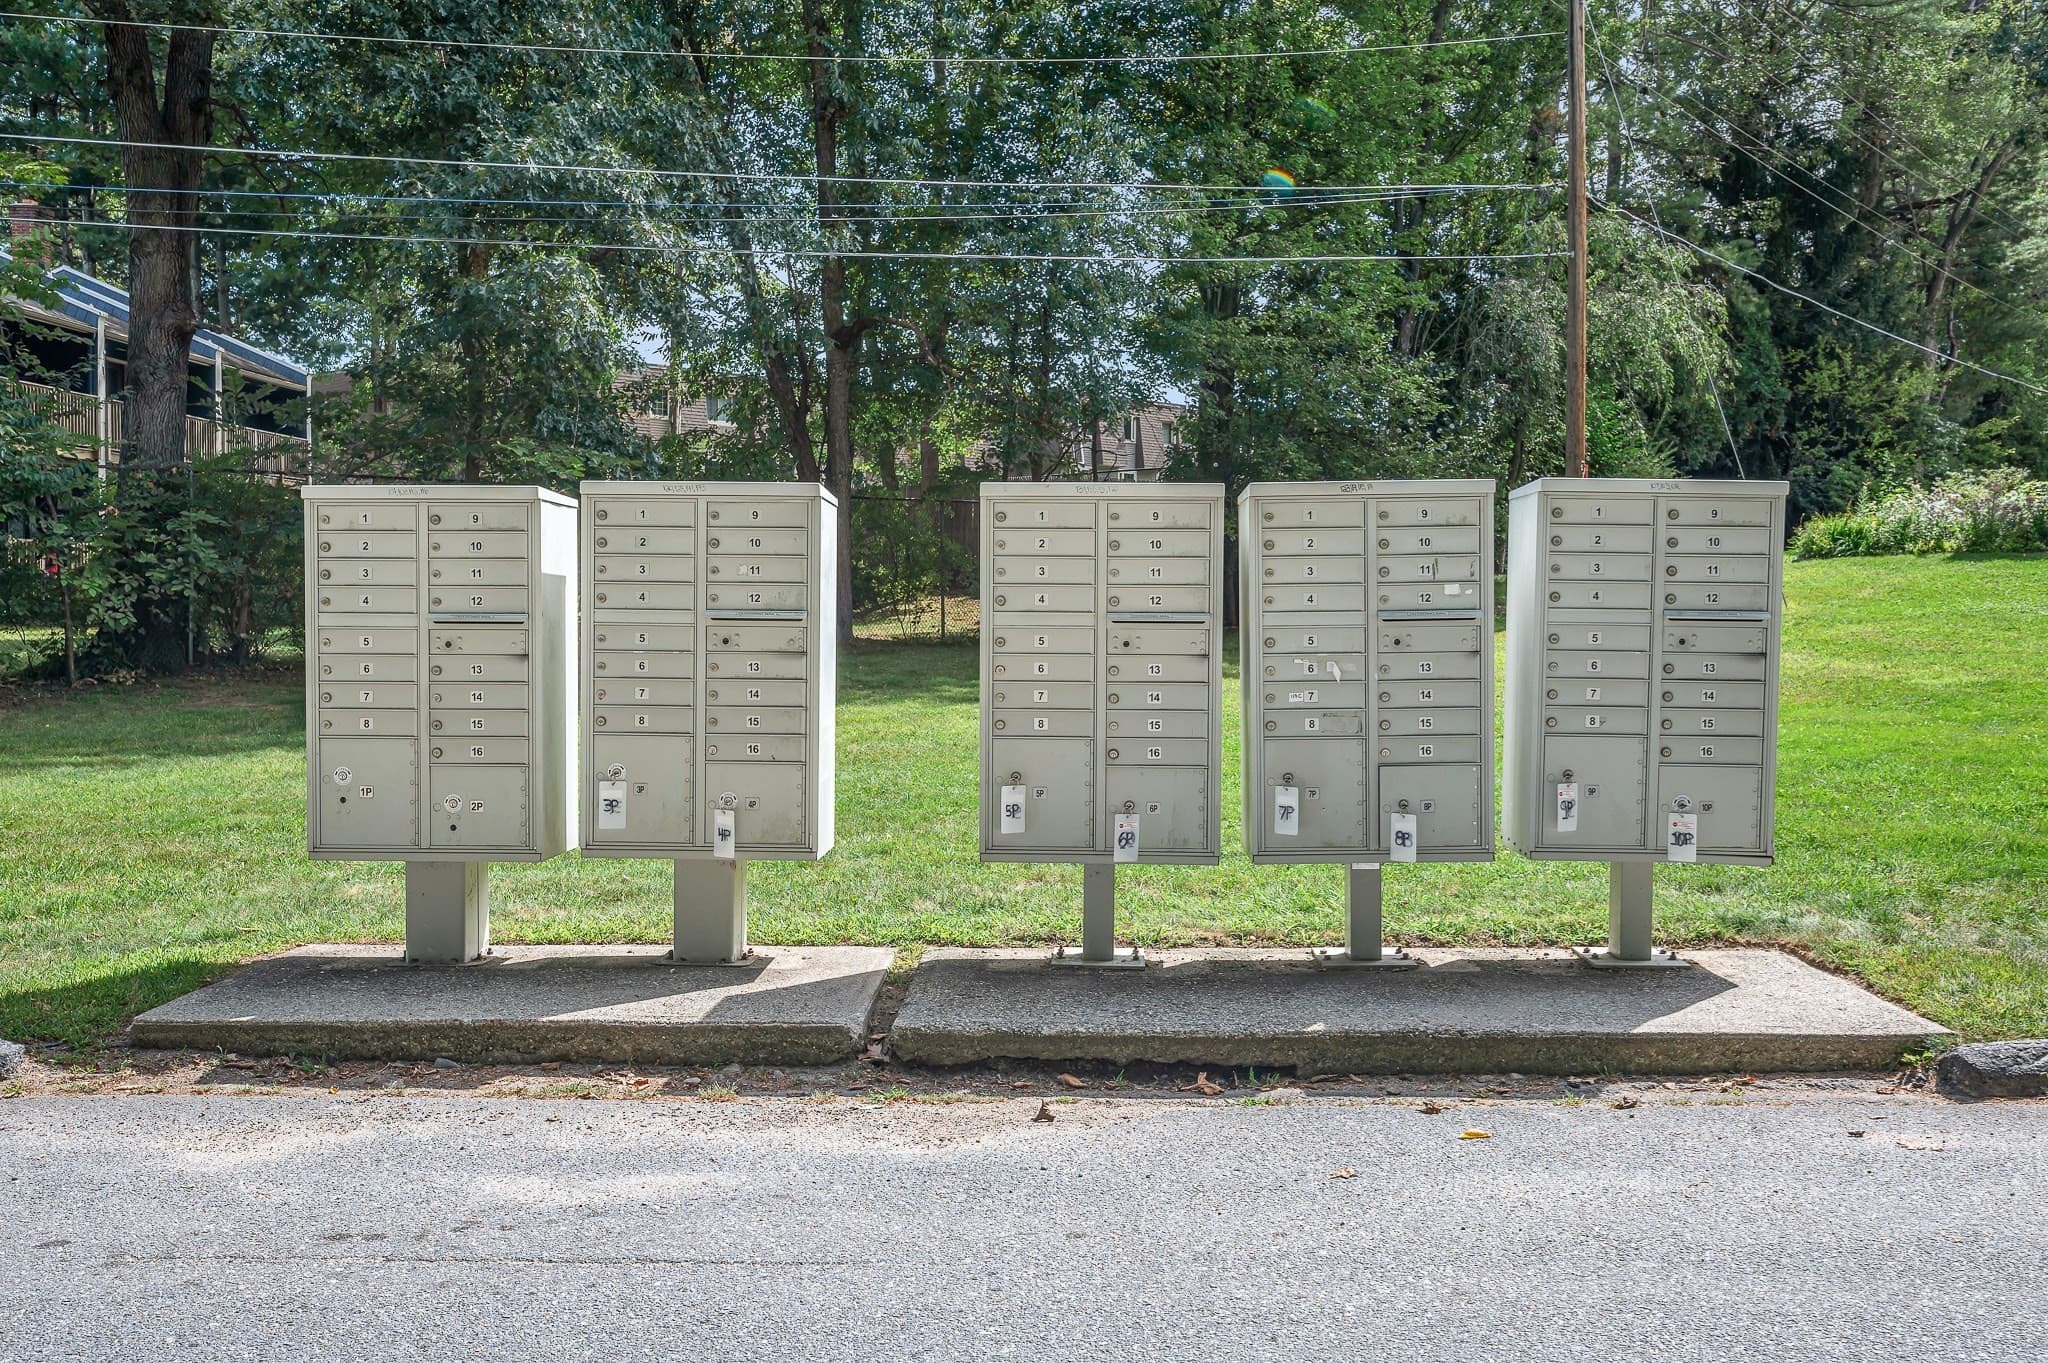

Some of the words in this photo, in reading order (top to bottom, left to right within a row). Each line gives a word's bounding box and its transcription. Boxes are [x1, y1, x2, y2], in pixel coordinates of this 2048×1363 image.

[640, 509, 645, 519] 1
[751, 510, 759, 520] 9
[1039, 511, 1044, 521] 1
[1152, 511, 1159, 521] 9
[1307, 510, 1312, 520] 1
[1421, 509, 1428, 519] 9
[1596, 507, 1601, 517] 1
[1711, 509, 1718, 519] 9
[362, 513, 368, 523] 1
[472, 514, 479, 524] 9
[639, 537, 647, 547] 2
[749, 538, 761, 548] 10
[1038, 538, 1046, 549] 2
[1149, 539, 1162, 550] 10
[1307, 538, 1314, 548] 2
[1418, 537, 1431, 547] 10
[1594, 535, 1601, 545] 2
[1708, 537, 1720, 547] 10
[362, 541, 369, 551] 2
[470, 541, 482, 551] 10
[362, 568, 369, 578] 3
[471, 568, 482, 578] 11
[639, 564, 646, 575] 3
[749, 565, 760, 575] 11
[1038, 566, 1045, 576] 3
[1150, 567, 1161, 577] 11
[1307, 566, 1314, 576] 3
[1419, 564, 1431, 575] 11
[1593, 563, 1601, 573] 3
[1707, 565, 1718, 575] 11
[362, 596, 369, 605] 4
[471, 596, 483, 606] 12
[638, 592, 646, 602] 4
[748, 593, 761, 603] 12
[1038, 594, 1045, 604] 4
[1149, 596, 1162, 606] 12
[1306, 594, 1314, 604] 4
[1419, 593, 1432, 603] 12
[1592, 591, 1600, 601] 4
[1705, 593, 1718, 603] 12
[363, 637, 370, 647] 5
[639, 633, 646, 643] 5
[1038, 636, 1045, 646] 5
[1307, 635, 1314, 646] 5
[1591, 633, 1599, 643] 5
[363, 664, 370, 674] 6
[471, 664, 483, 675] 13
[638, 661, 646, 671] 6
[748, 662, 760, 672] 13
[1038, 664, 1045, 674] 6
[1149, 665, 1161, 675] 13
[1307, 663, 1315, 674] 6
[1419, 662, 1432, 673] 13
[1591, 660, 1598, 671] 6
[1703, 663, 1716, 673] 13
[363, 692, 370, 702] 7
[471, 692, 483, 702] 14
[639, 688, 646, 698] 7
[748, 689, 760, 699] 14
[1037, 691, 1045, 702] 7
[1148, 692, 1160, 702] 14
[1307, 691, 1315, 701] 7
[1420, 690, 1432, 700] 14
[1590, 688, 1597, 698] 7
[1702, 691, 1715, 701] 14
[363, 719, 370, 729] 8
[471, 719, 483, 729] 15
[638, 715, 645, 726] 8
[747, 716, 760, 727] 15
[1037, 718, 1045, 729] 8
[1148, 720, 1161, 730] 15
[1308, 719, 1316, 729] 8
[1419, 718, 1432, 728] 15
[1588, 716, 1596, 726] 8
[1701, 719, 1714, 729] 15
[471, 747, 483, 757] 16
[747, 744, 760, 754] 16
[1148, 748, 1161, 758] 16
[1419, 745, 1432, 756] 16
[1700, 746, 1713, 757] 16
[360, 787, 372, 797] 1P
[1035, 789, 1045, 798] 5P
[1308, 789, 1317, 798] 7P
[471, 802, 483, 812] 2P
[602, 798, 619, 813] 3P
[1149, 804, 1158, 813] 6P
[1005, 803, 1021, 819] 5P
[1278, 805, 1295, 821] 7P
[718, 827, 731, 842] 4P
